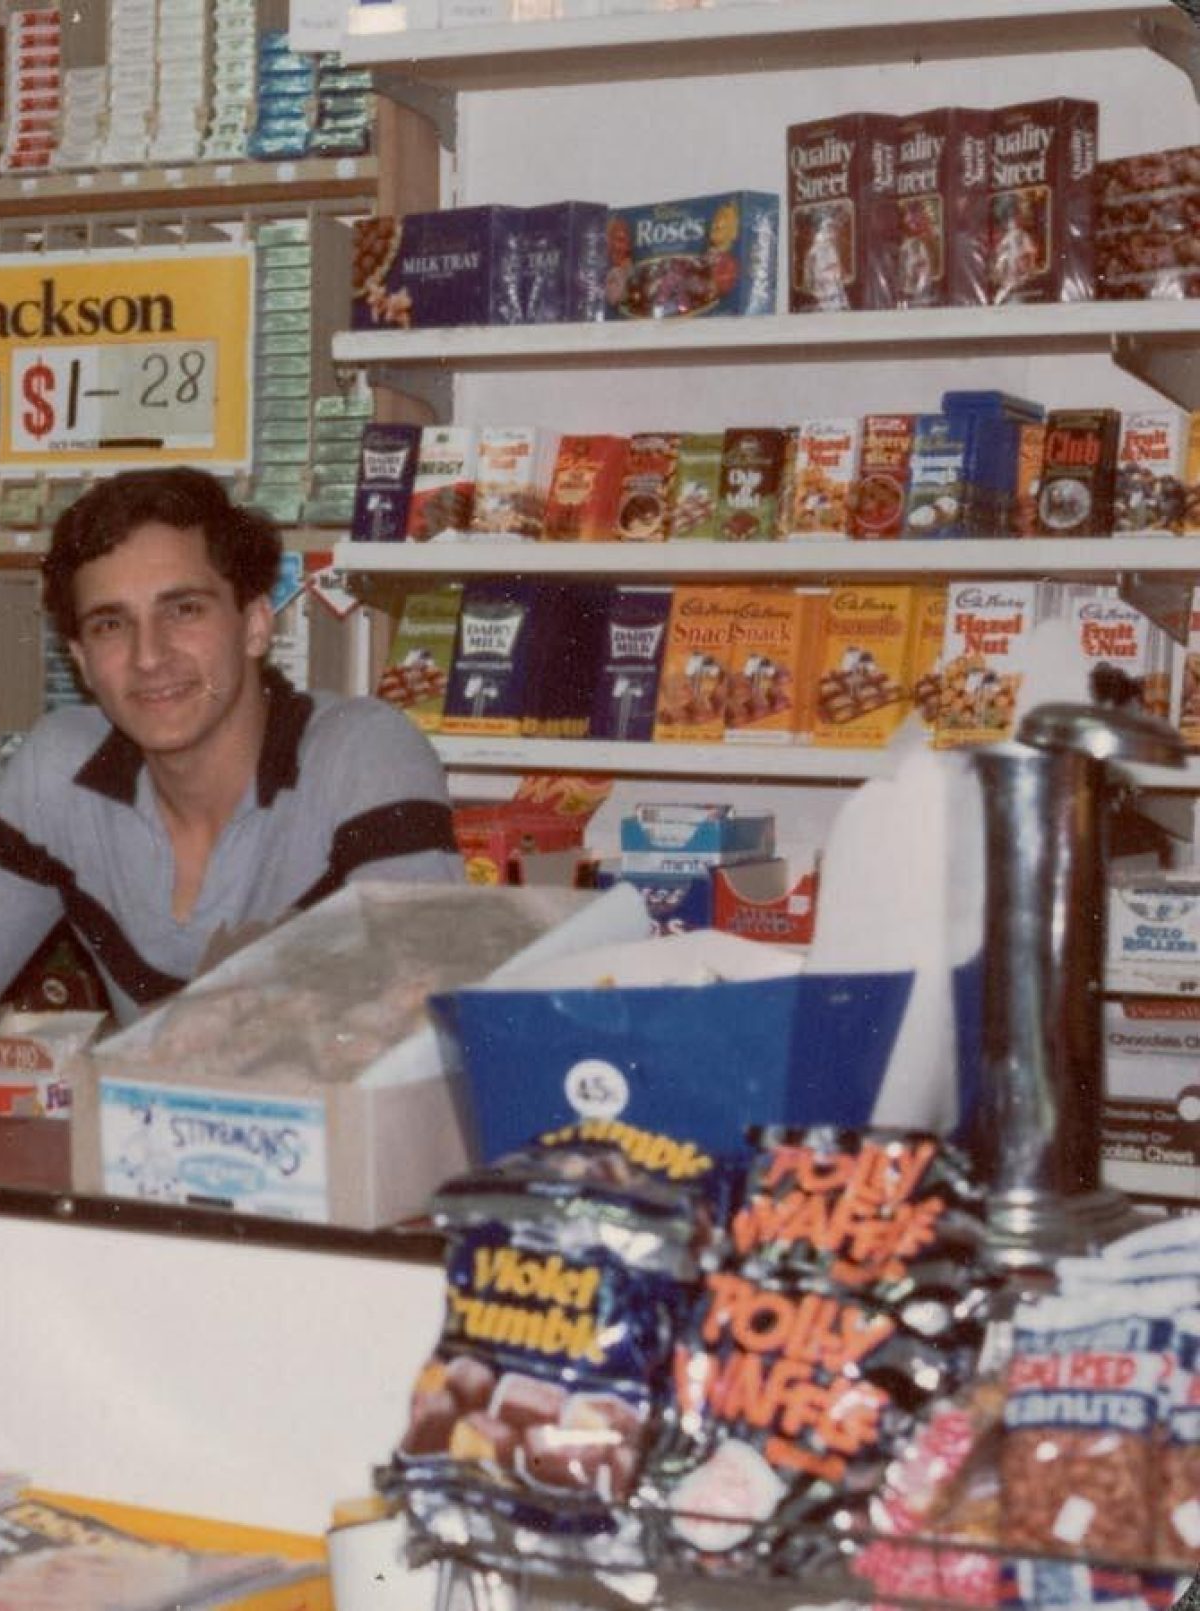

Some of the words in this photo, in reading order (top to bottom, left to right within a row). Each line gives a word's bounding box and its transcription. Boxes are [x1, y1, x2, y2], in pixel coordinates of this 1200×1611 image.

[637, 217, 705, 248] Roses
[402, 257, 444, 275] MILK
[445, 252, 480, 272] TRAY
[140, 350, 206, 409] 28
[954, 613, 1023, 634] Hazel
[965, 632, 1009, 655] Nut
[473, 1247, 601, 1311] Violet
[703, 1273, 899, 1370] POLLY
